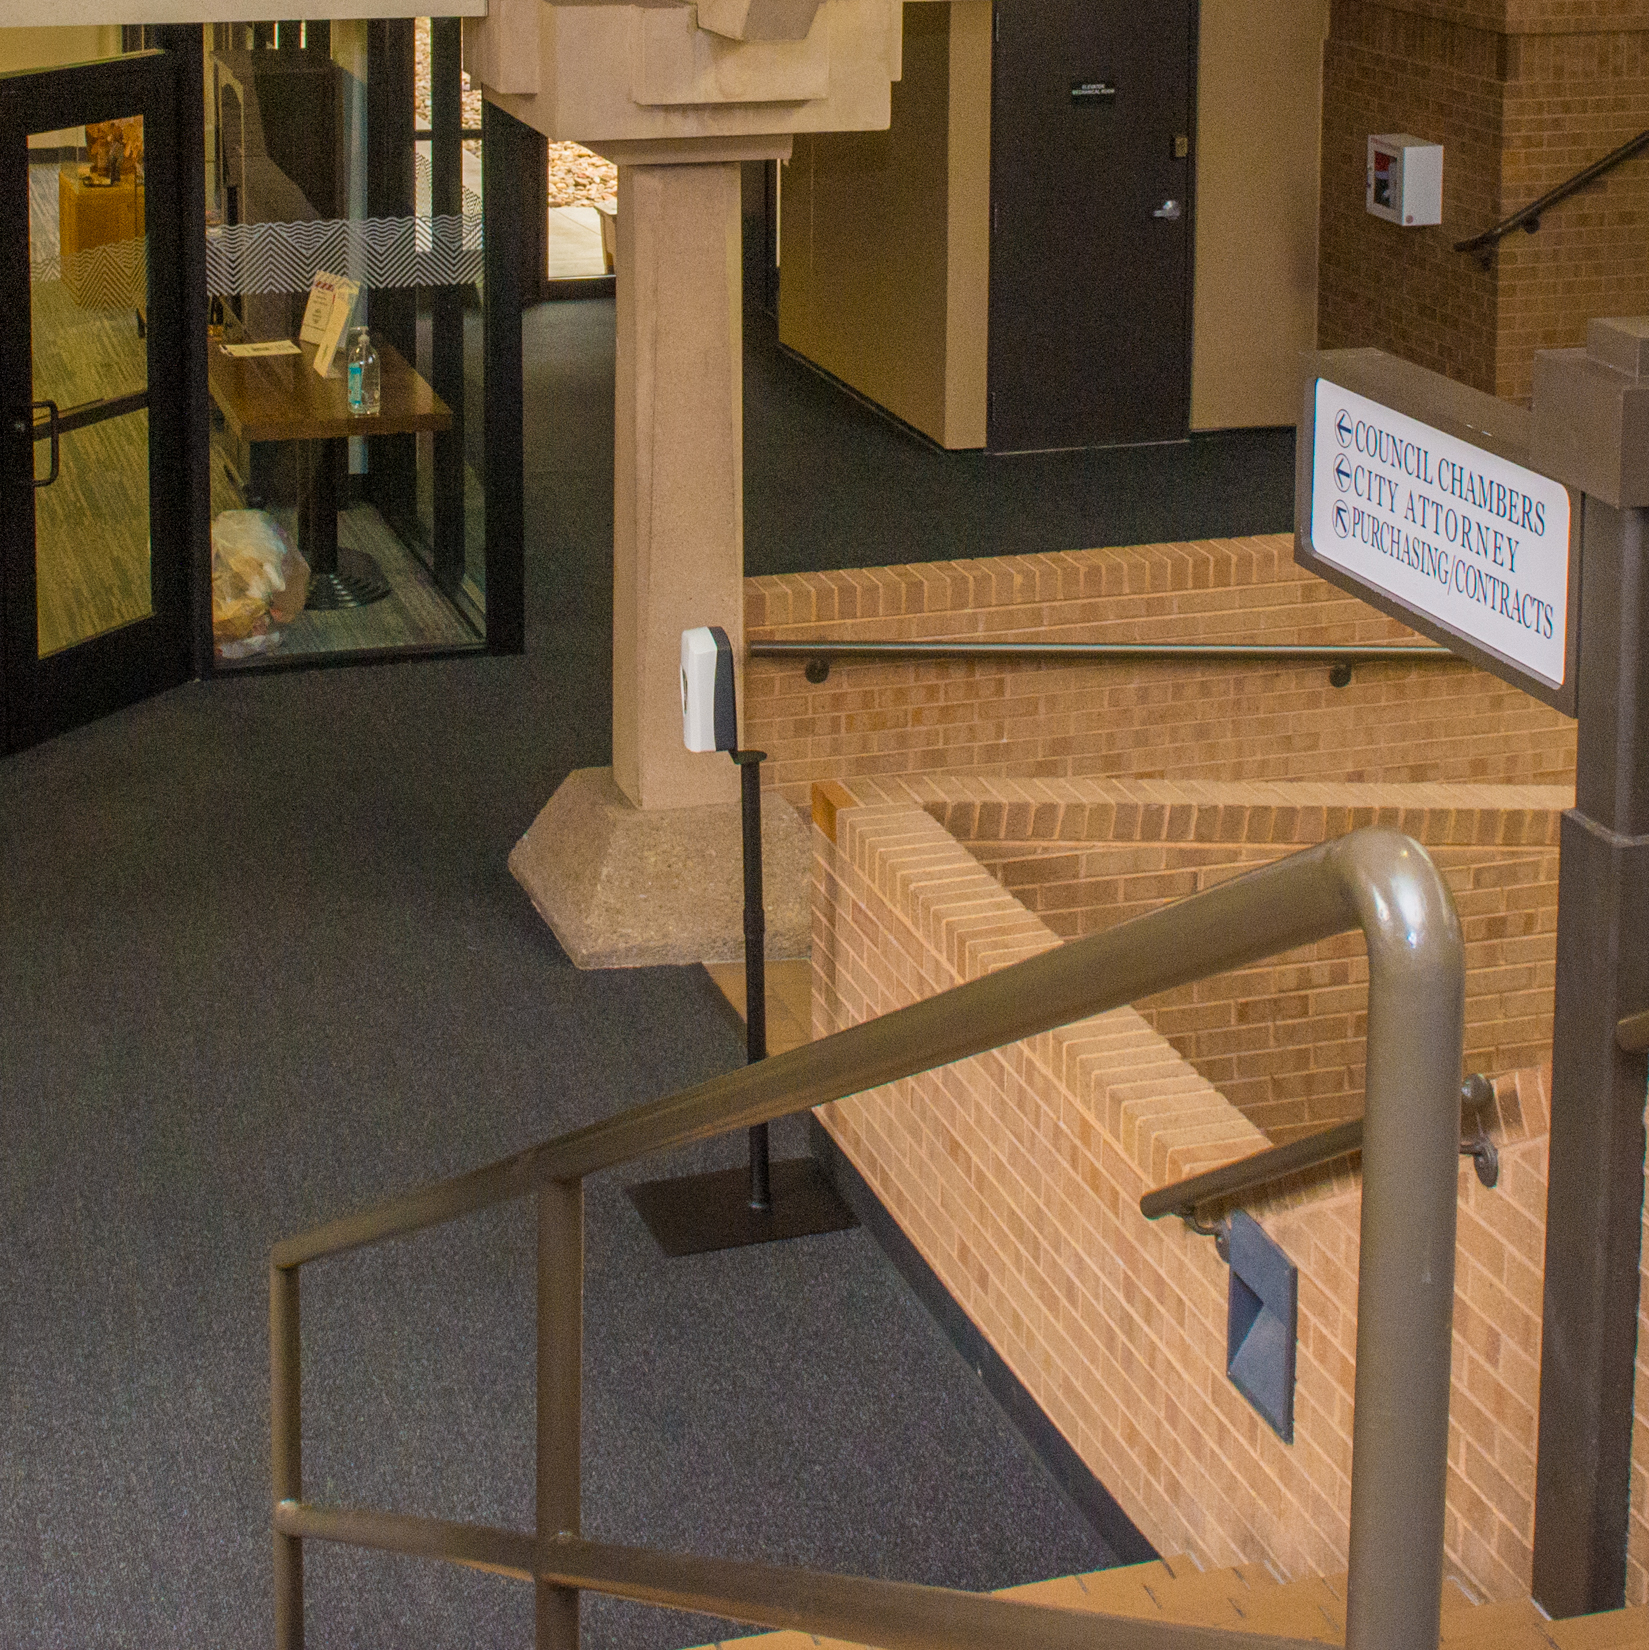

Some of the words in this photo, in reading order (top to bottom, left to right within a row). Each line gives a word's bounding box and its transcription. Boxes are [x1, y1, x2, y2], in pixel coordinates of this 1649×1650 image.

[1354, 465, 1398, 513] CITY
[1404, 489, 1520, 573] ATTORNEY
[1355, 420, 1433, 485] COUNCIL
[1438, 457, 1545, 537] CHAMBERS
[1352, 506, 1553, 640] PURCHASING/CONTRACTS
